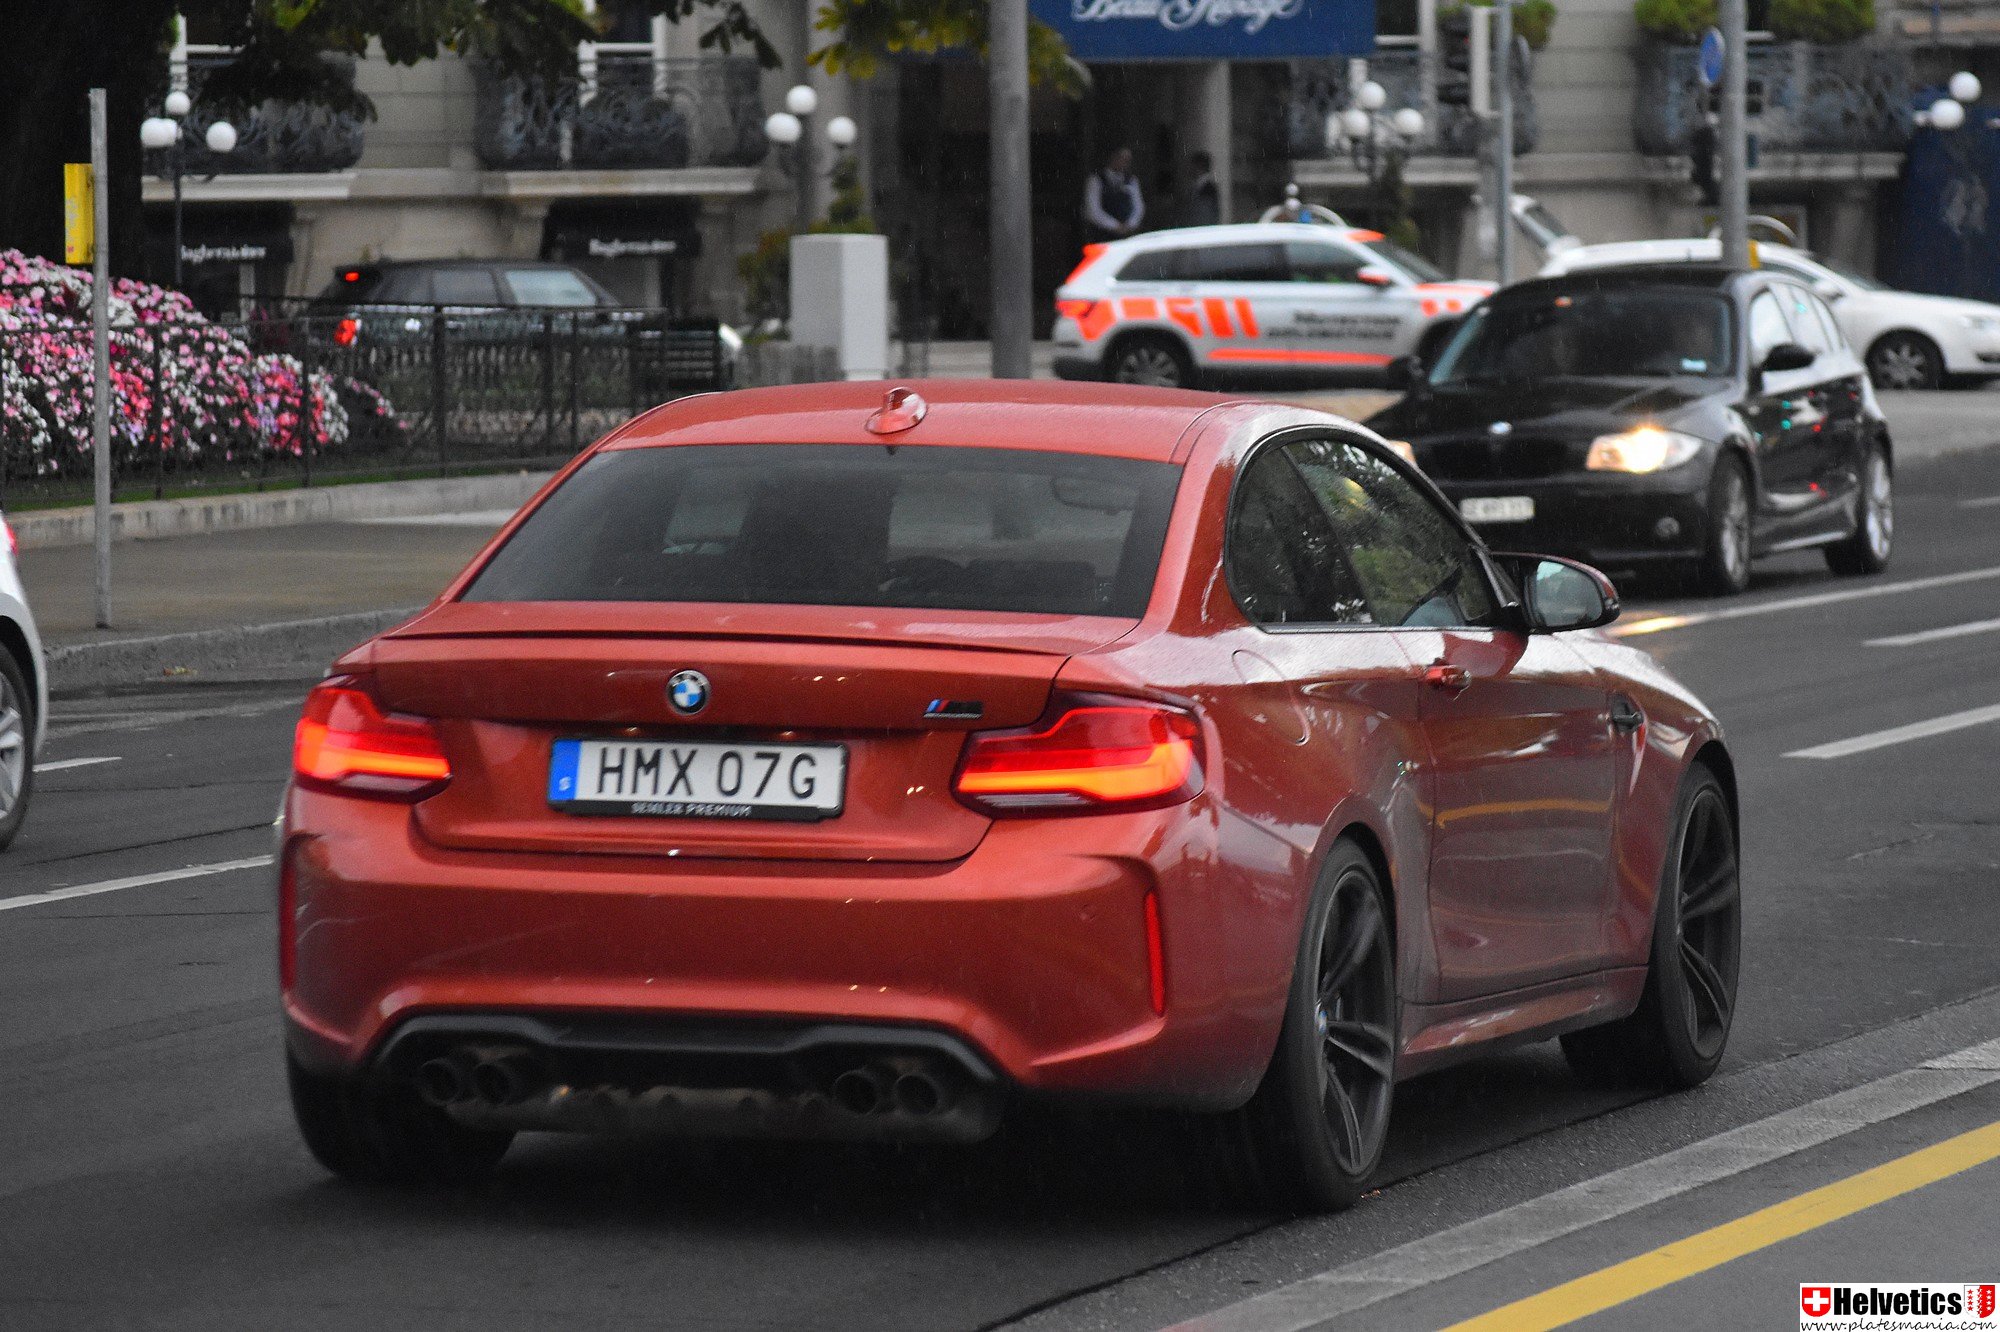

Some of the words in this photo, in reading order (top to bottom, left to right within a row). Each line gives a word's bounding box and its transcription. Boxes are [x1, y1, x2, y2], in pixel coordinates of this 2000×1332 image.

[596, 746, 699, 797] HMX
[716, 749, 817, 800] 07G
[685, 803, 752, 818] PREMIUM
